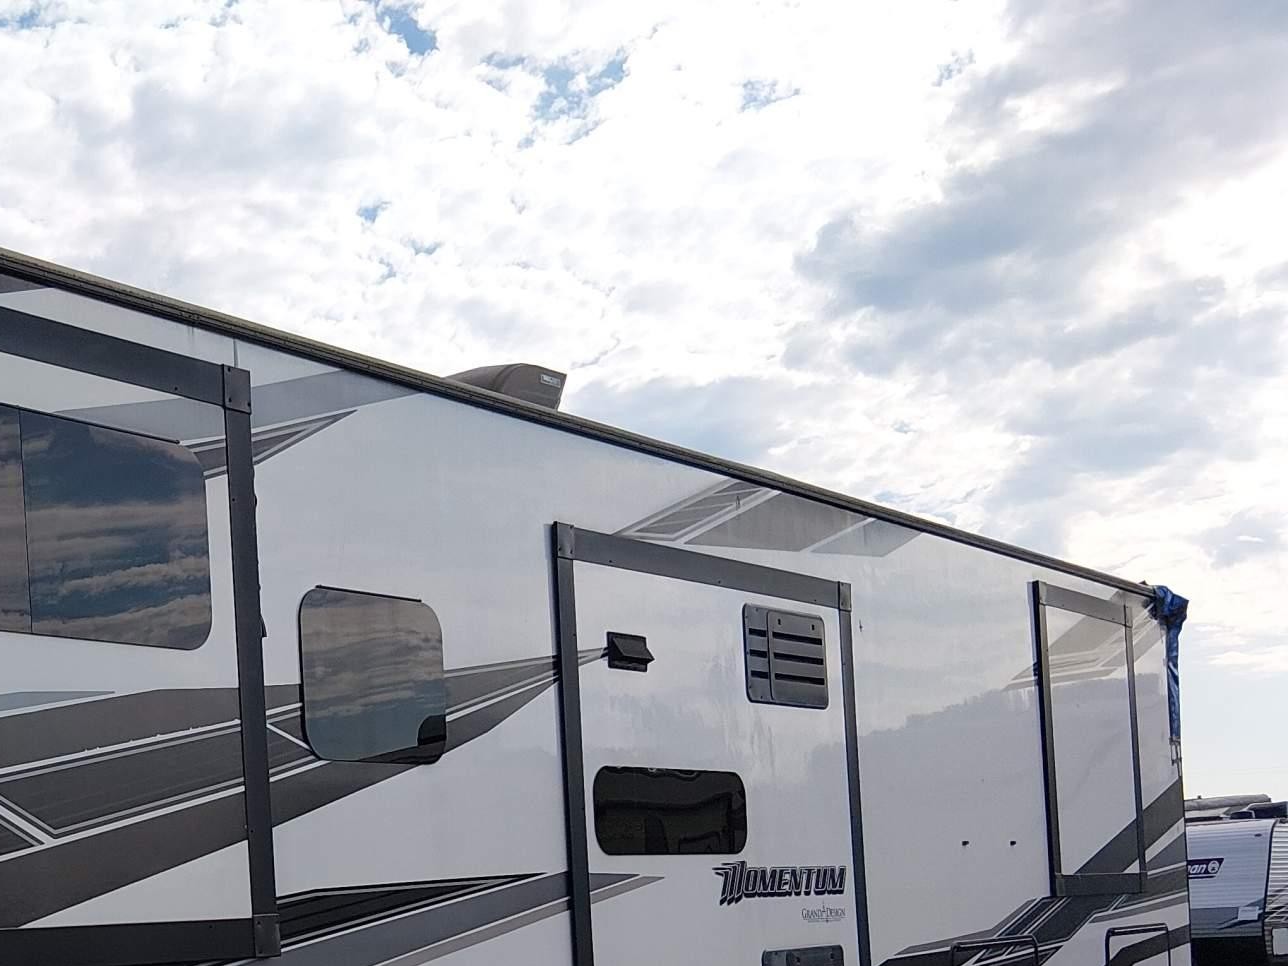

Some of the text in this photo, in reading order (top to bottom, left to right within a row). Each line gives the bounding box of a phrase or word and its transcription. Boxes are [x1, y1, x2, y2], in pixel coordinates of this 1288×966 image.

[712, 861, 847, 906] MOMENTUM
[801, 907, 846, 919] GRAND DESIGN
